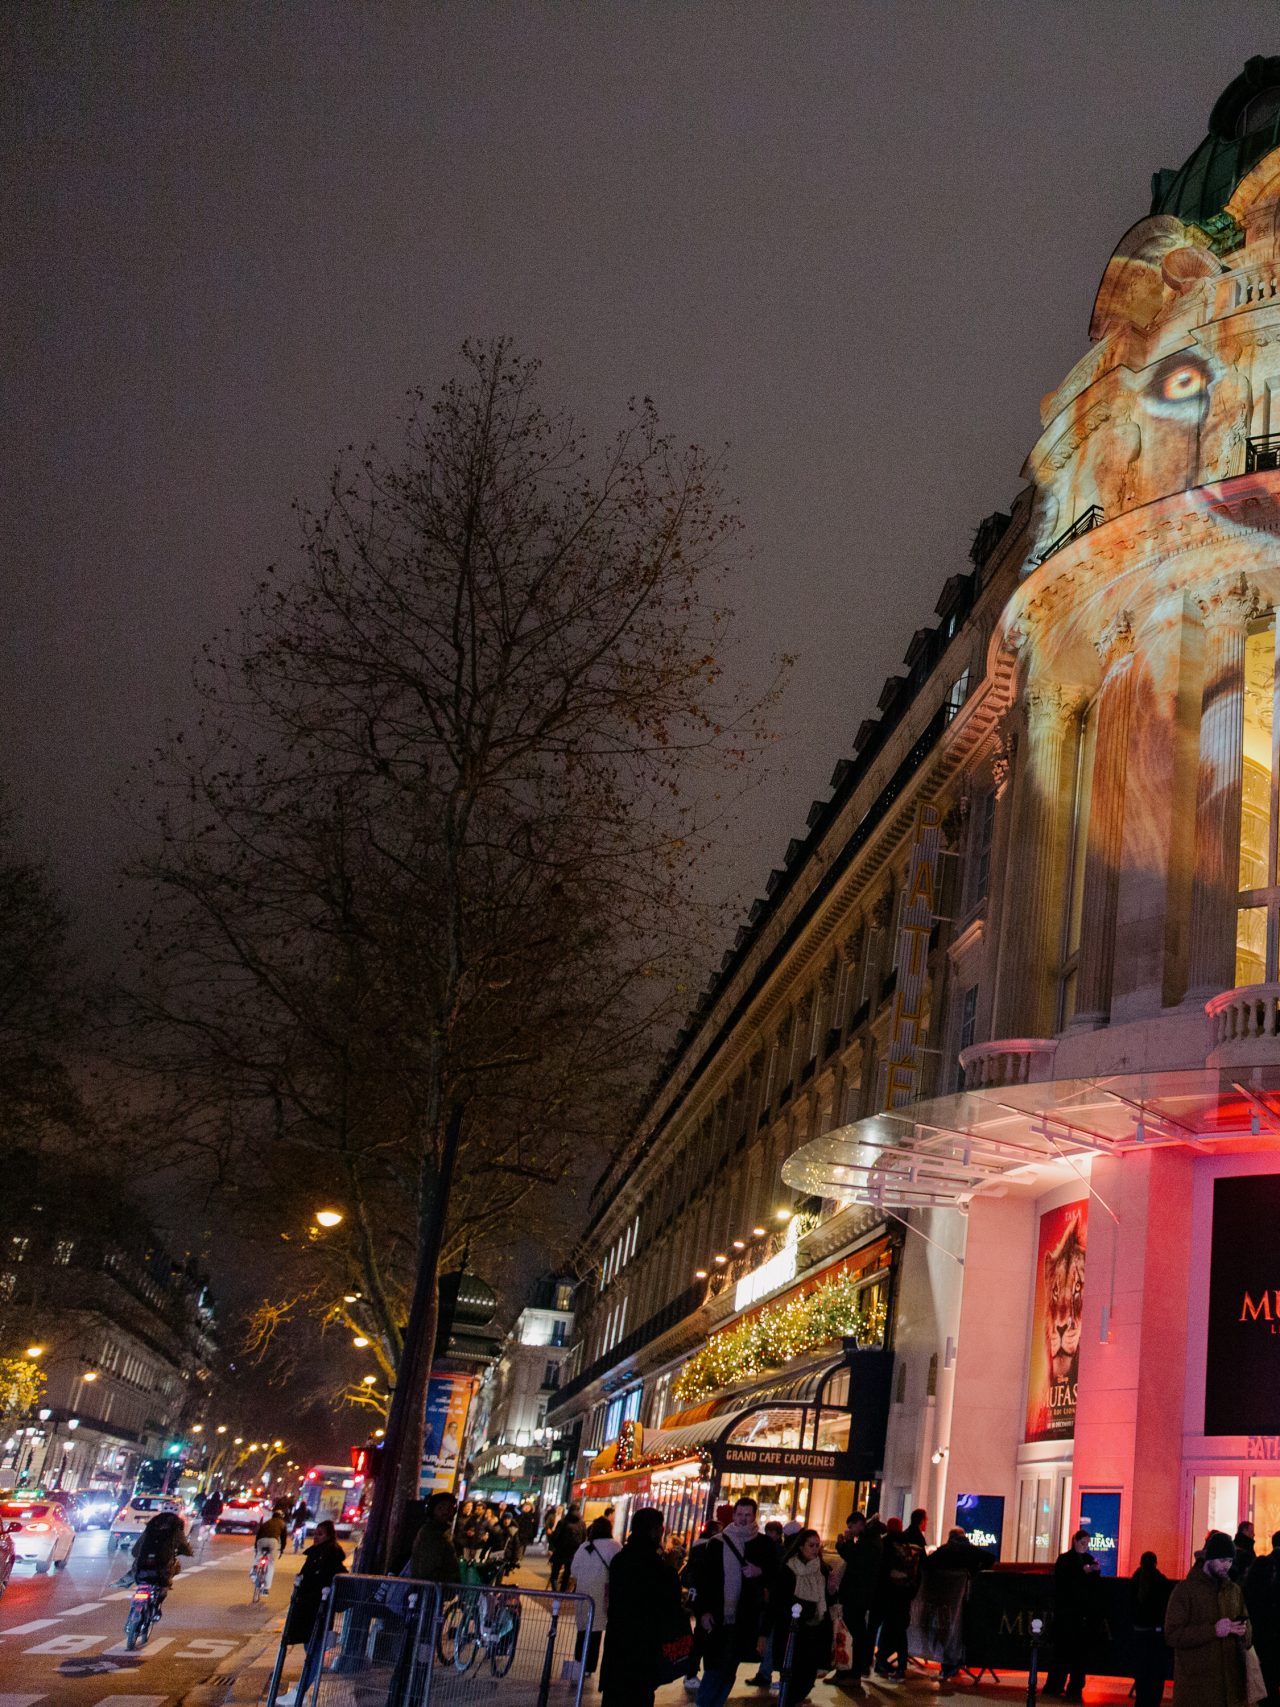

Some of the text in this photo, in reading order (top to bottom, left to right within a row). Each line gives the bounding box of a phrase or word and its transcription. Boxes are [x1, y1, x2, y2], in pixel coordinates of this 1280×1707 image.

[885, 801, 942, 1111] PATHÉ
[726, 1450, 756, 1461] GRAND
[784, 1454, 835, 1466] CAPUCINES
[21, 1635, 239, 1658] BUS
